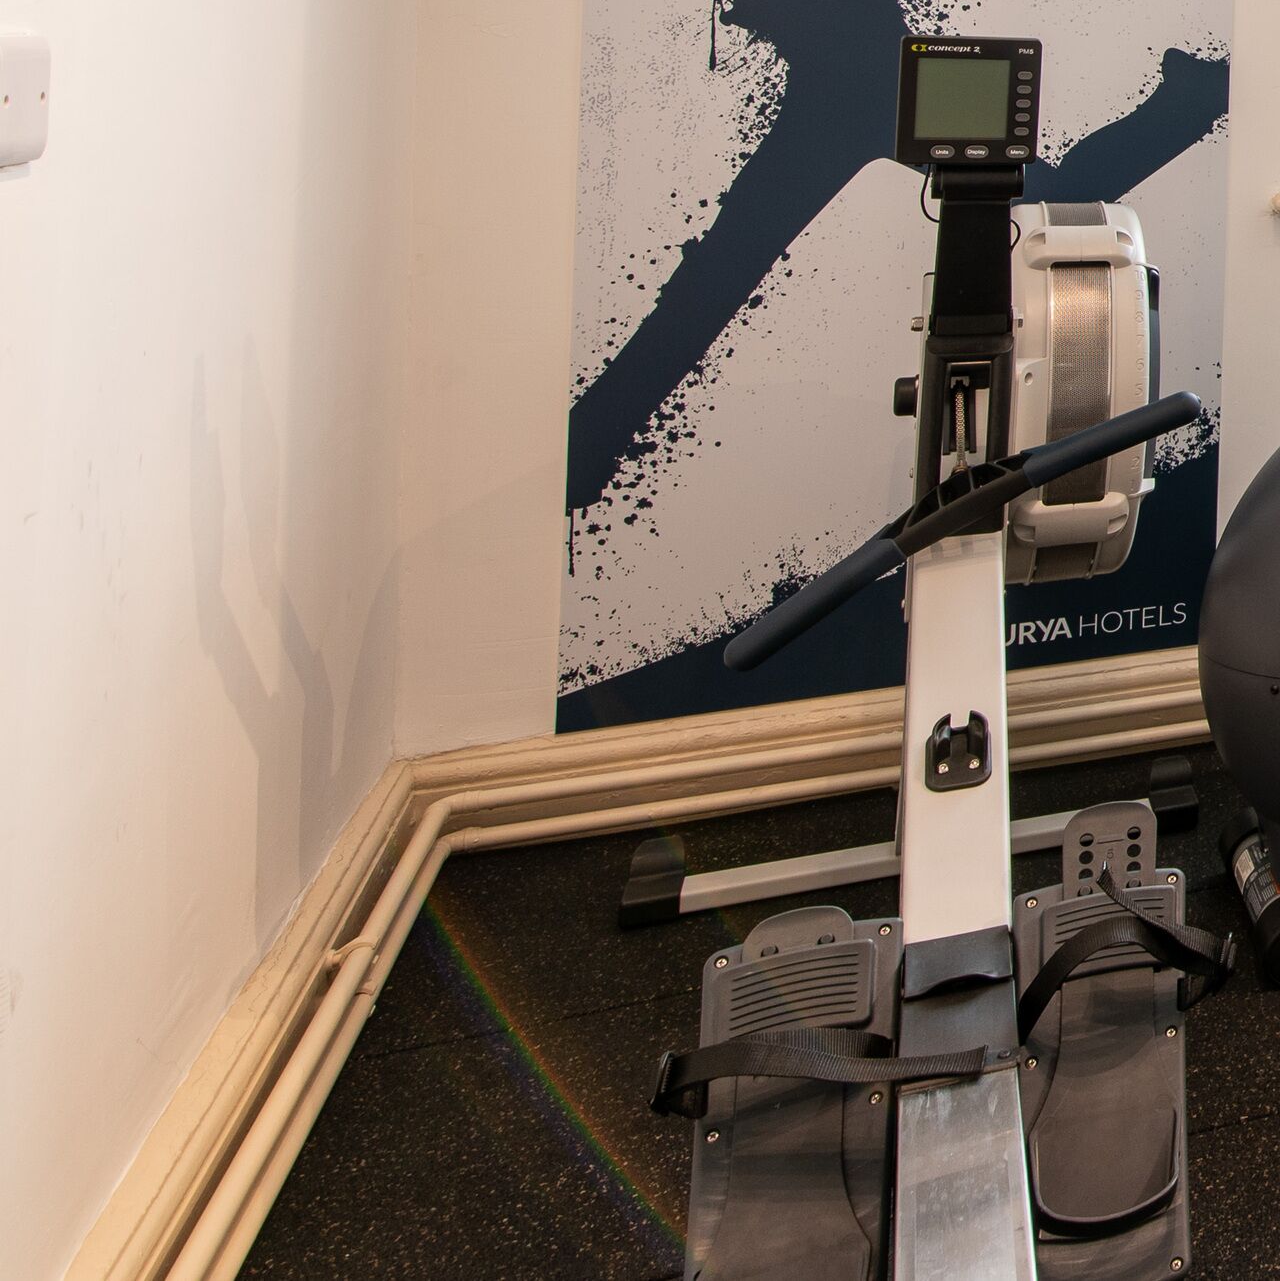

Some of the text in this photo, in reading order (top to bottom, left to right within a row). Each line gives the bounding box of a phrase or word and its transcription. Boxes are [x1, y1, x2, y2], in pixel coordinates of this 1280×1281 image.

[928, 45, 971, 53] concept
[1005, 603, 1187, 647] URYA HOTELS
